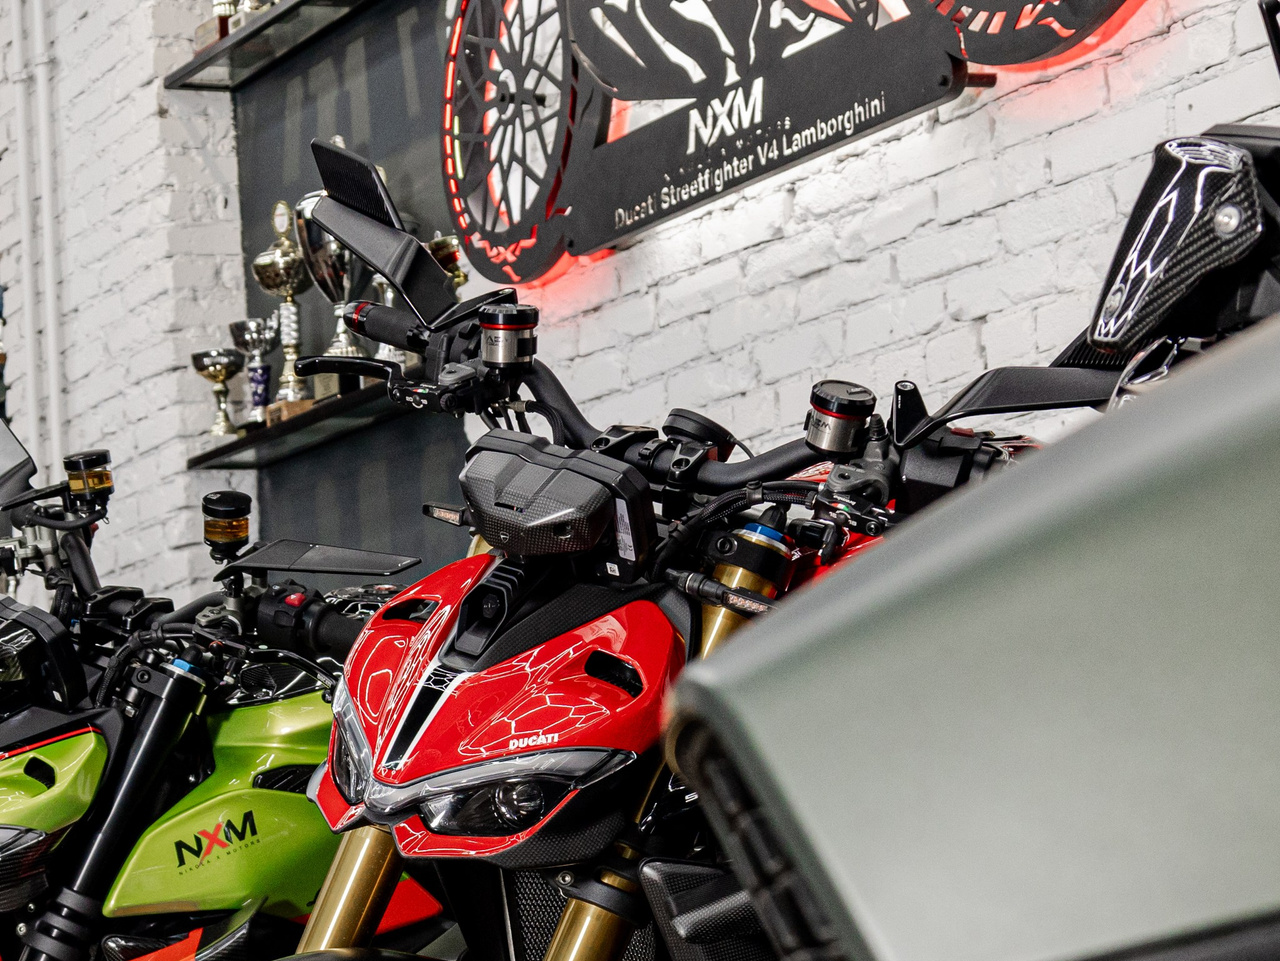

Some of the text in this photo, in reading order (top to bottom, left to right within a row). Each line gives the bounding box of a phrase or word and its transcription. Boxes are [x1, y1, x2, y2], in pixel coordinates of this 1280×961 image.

[660, 154, 754, 210] Streetfighter
[757, 138, 779, 166] V4
[782, 90, 886, 156] Lamborghini
[686, 76, 764, 155] NXM
[509, 733, 559, 750] DUCATI
[174, 809, 258, 868] NXM
